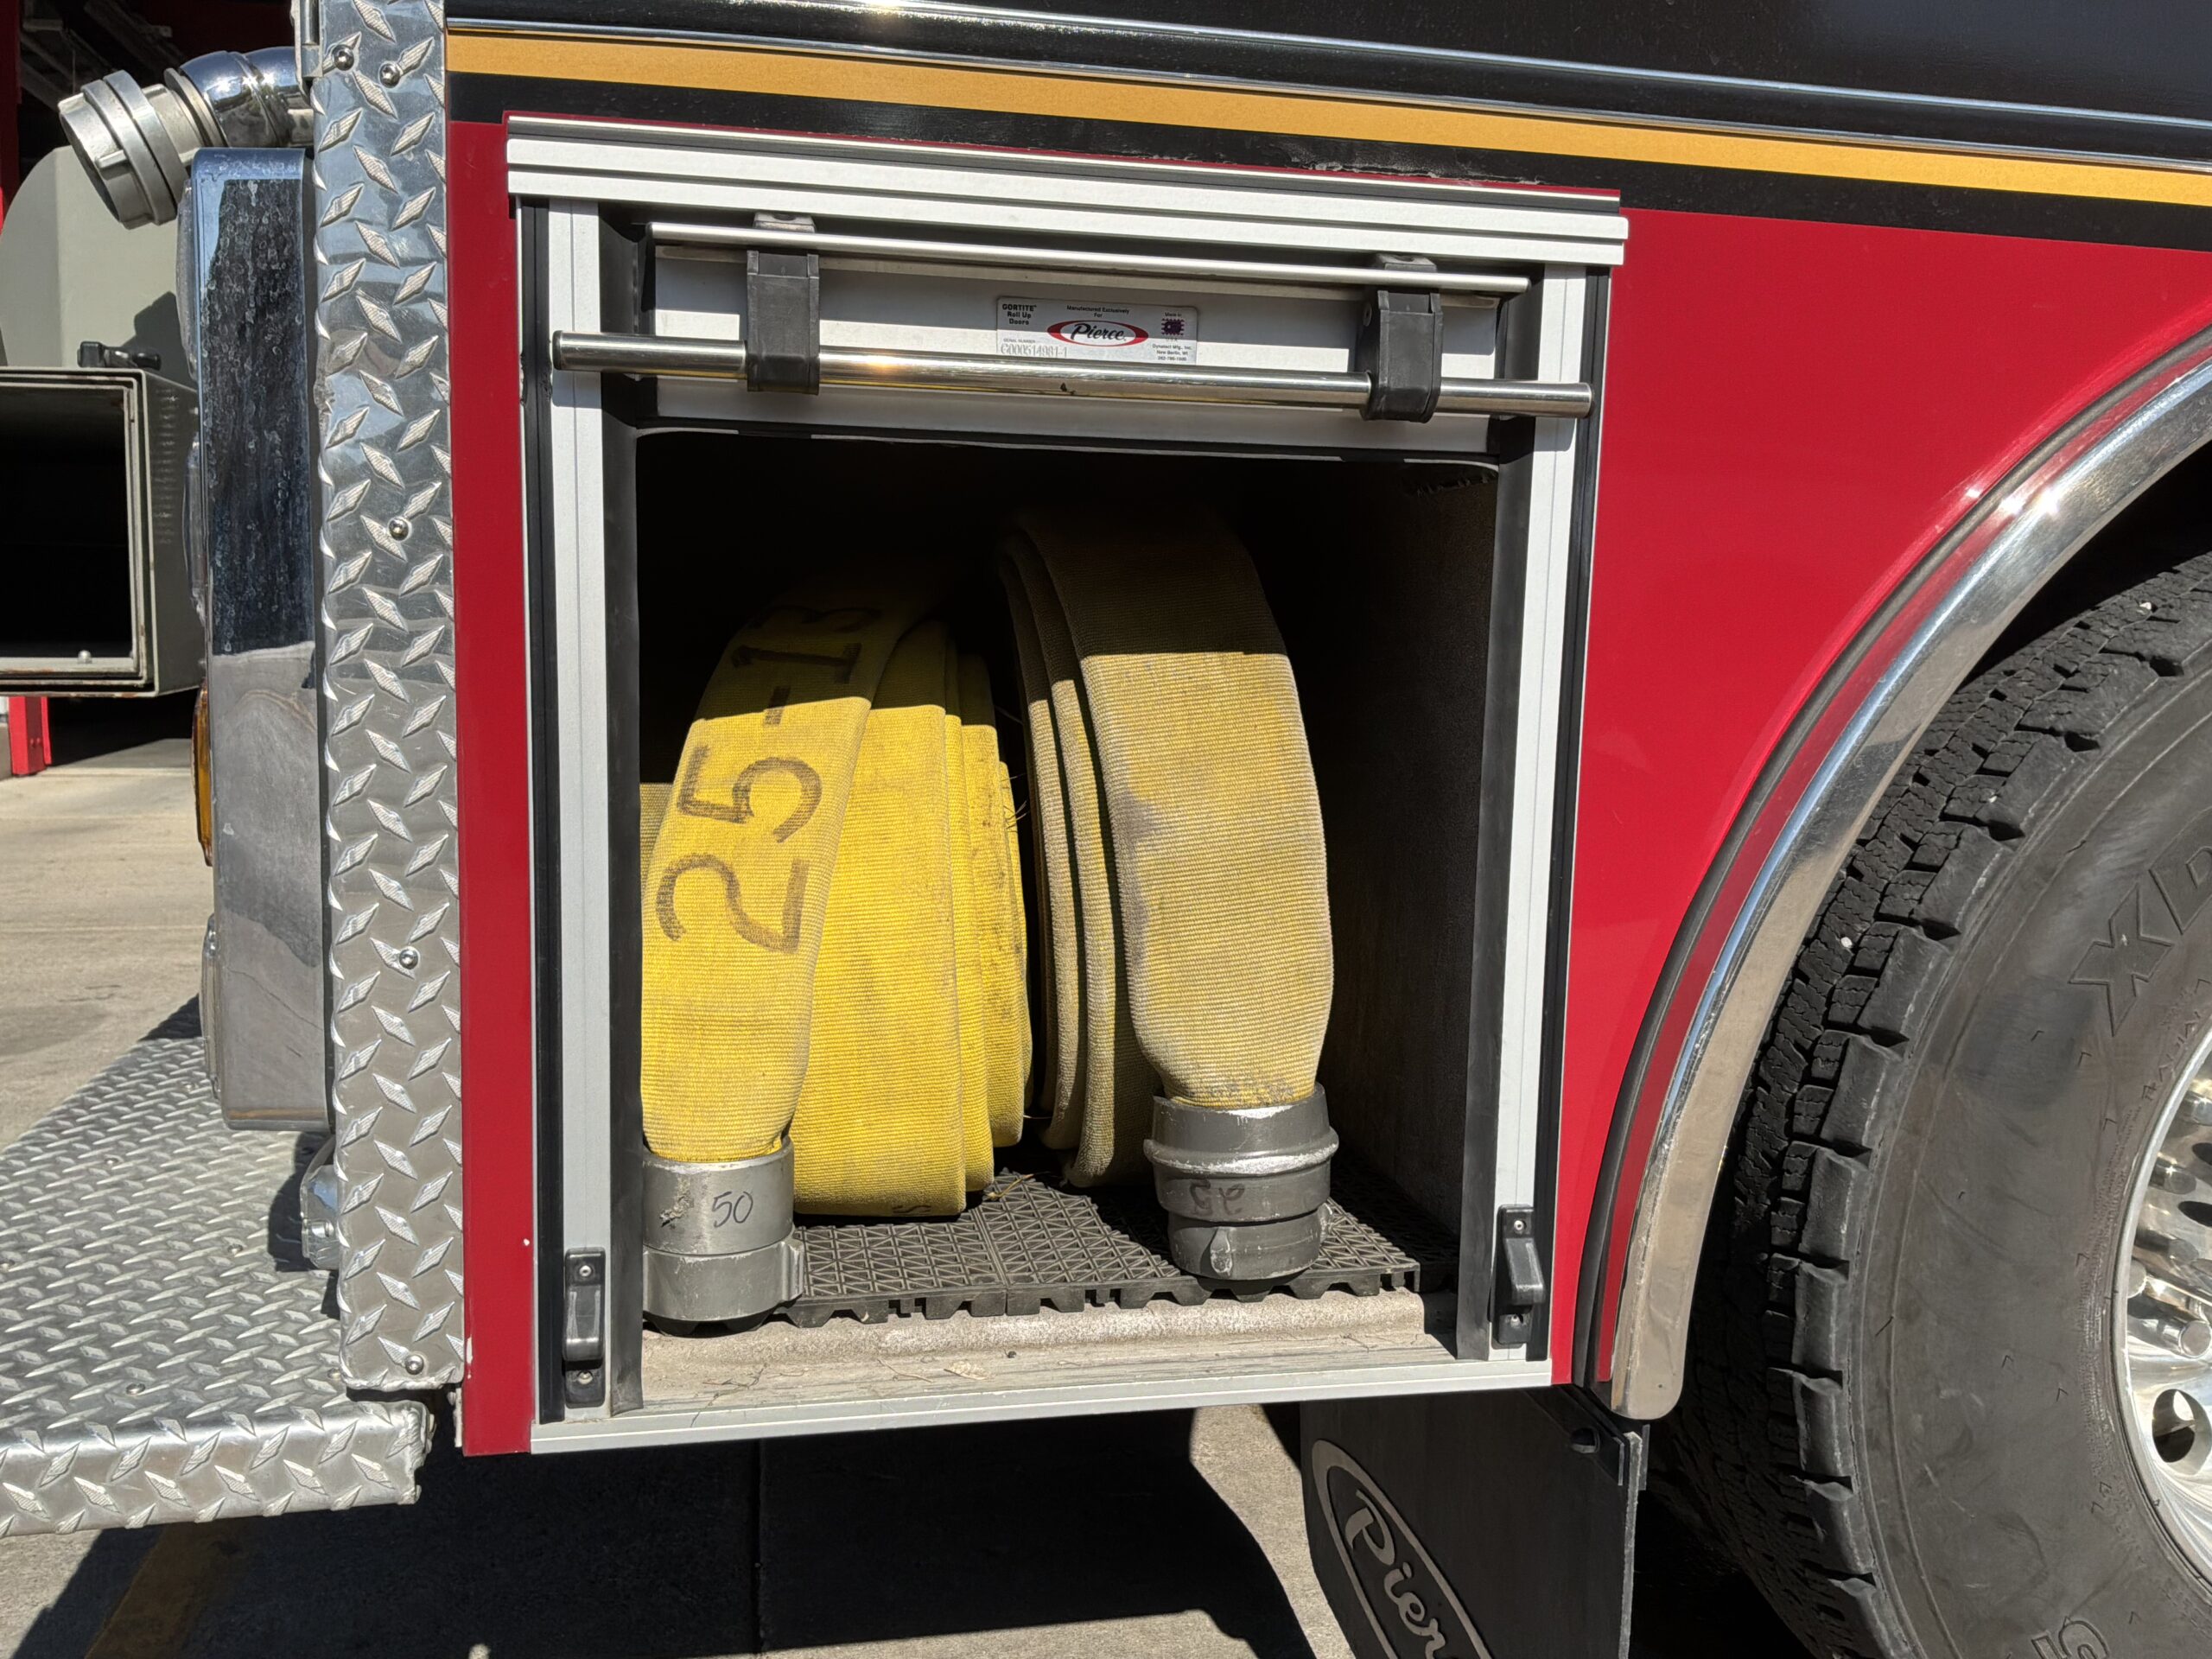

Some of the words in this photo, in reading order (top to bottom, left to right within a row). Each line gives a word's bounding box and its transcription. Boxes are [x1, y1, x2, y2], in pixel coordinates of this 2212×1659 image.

[1002, 303, 1035, 312] GORTITE
[1071, 322, 1124, 340] Pierce
[711, 1191, 753, 1228] 50
